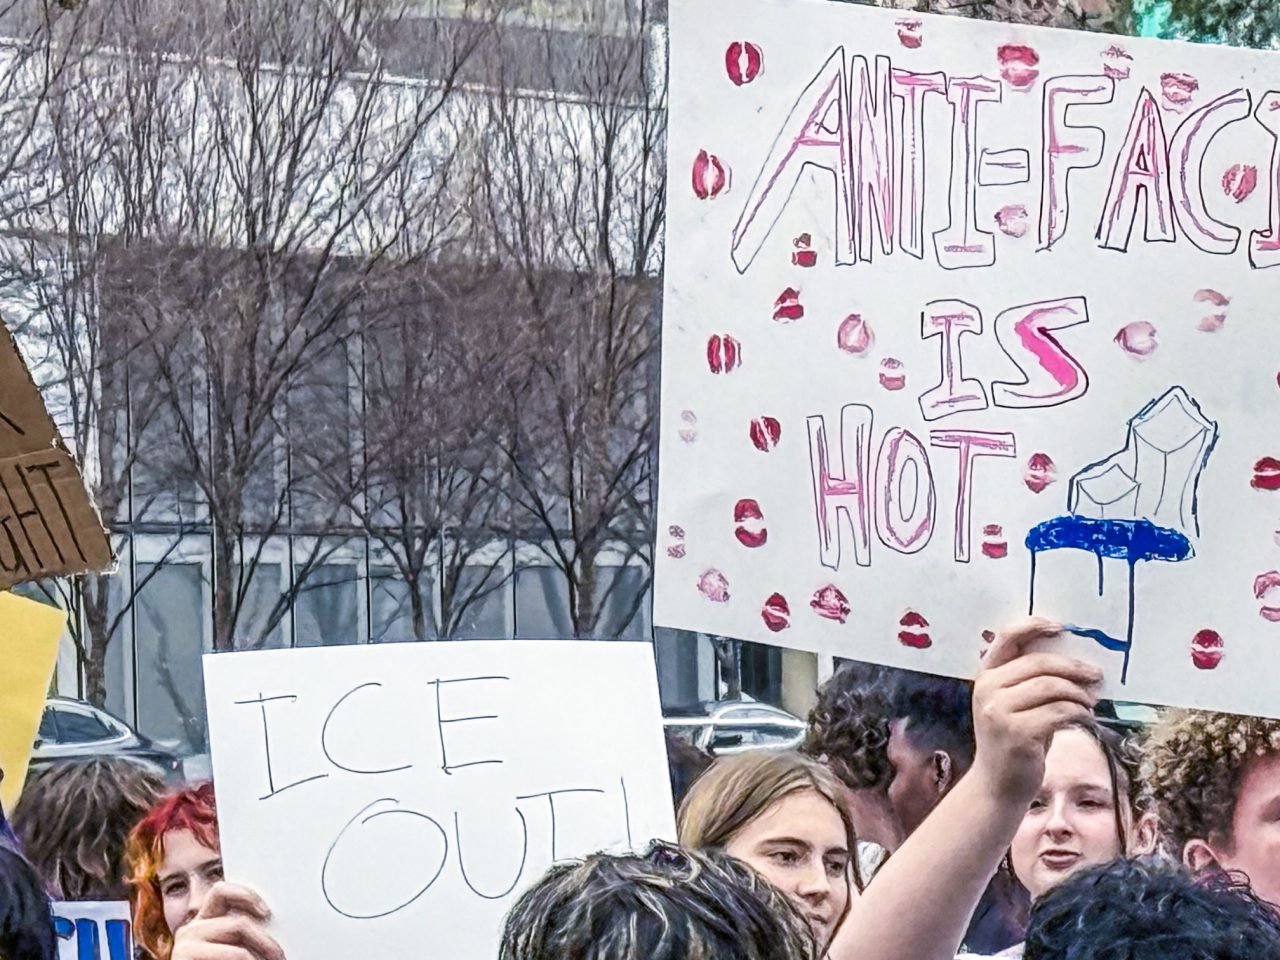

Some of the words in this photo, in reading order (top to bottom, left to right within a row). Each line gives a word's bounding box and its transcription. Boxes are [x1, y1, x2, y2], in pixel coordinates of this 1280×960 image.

[919, 296, 1090, 421] IS
[806, 403, 1016, 569] HOT
[234, 676, 510, 800] ICE
